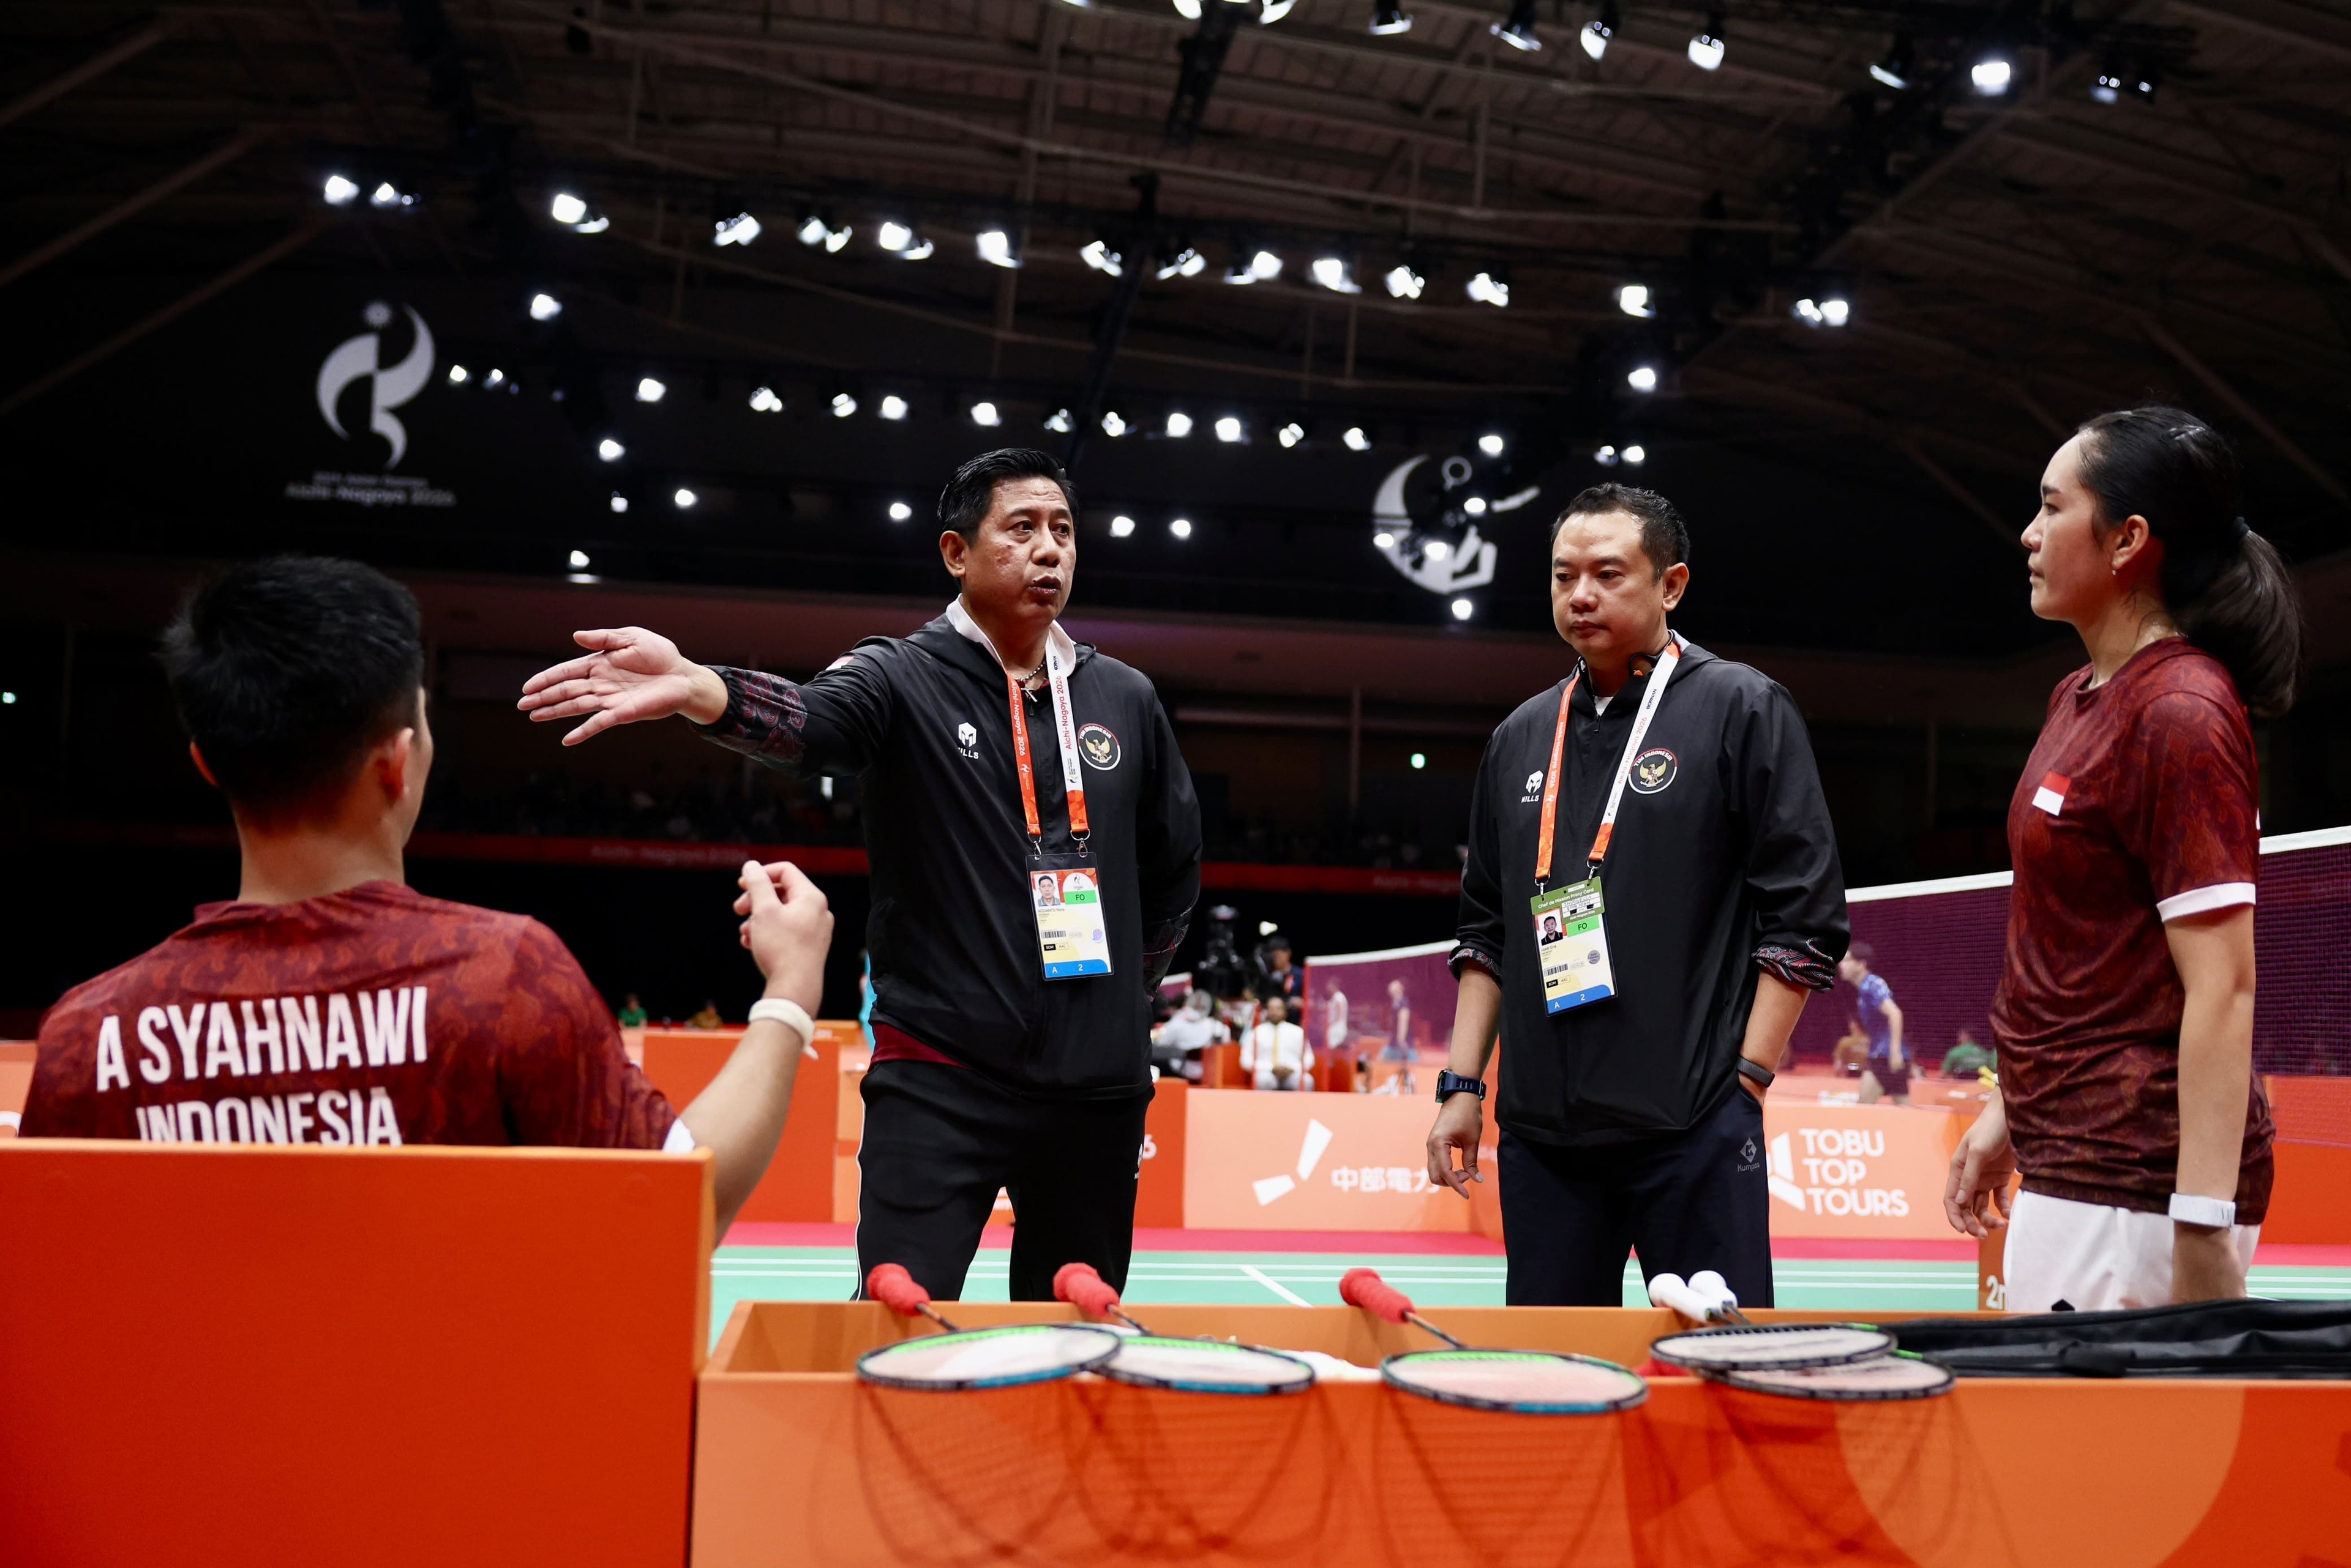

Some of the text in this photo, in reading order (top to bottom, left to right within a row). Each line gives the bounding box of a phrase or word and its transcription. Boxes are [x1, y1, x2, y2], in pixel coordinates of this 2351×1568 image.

[1011, 681, 1022, 735] Aichi-Nagoya
[1056, 675, 1071, 749] Aichi-Nagoya 2026
[1636, 717, 1647, 734] 2026
[958, 747, 979, 759] ILLS
[1633, 750, 1673, 767] TIM INDONESIA
[1555, 895, 1570, 904] Mission
[97, 986, 428, 1092] A SYAHNAWI
[1798, 1128, 1885, 1157] TOBU
[1802, 1158, 1867, 1186] TOP
[1806, 1187, 1910, 1217] TOURS
